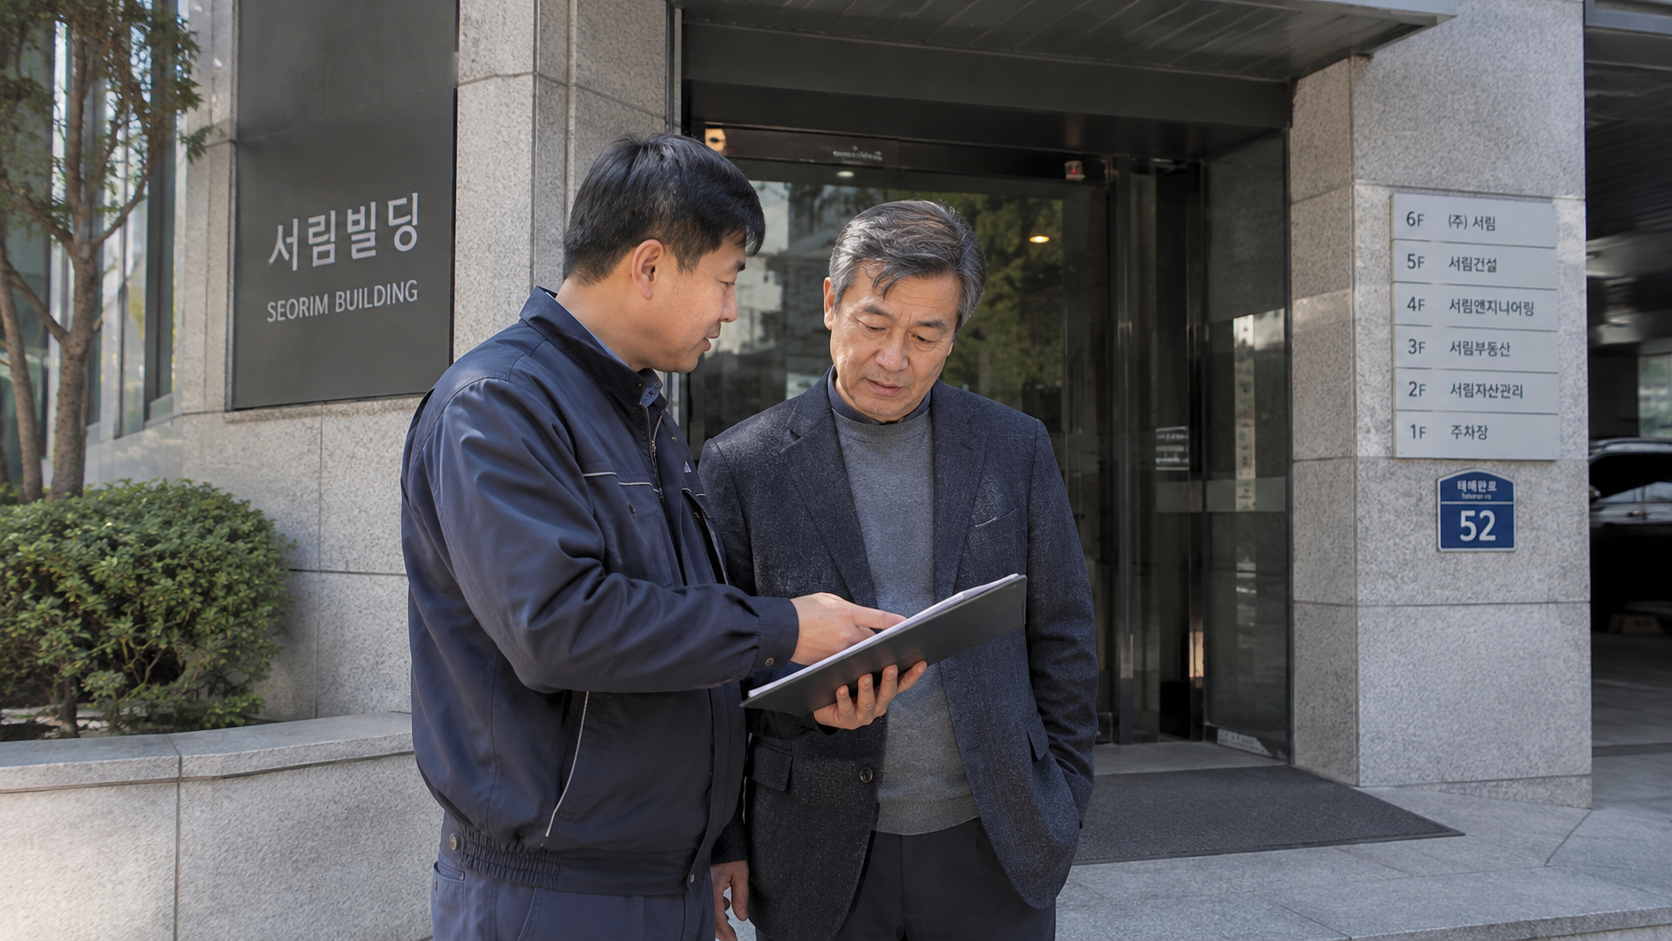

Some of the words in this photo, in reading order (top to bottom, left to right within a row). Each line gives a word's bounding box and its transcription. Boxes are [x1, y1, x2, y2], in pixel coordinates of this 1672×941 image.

[1406, 210, 1425, 227] 6F
[1447, 213, 1468, 230] (주)
[1472, 215, 1496, 231] 서림
[267, 192, 419, 271] 서림빌딩
[1406, 253, 1425, 270] 5F
[1448, 255, 1497, 273] 서림건설
[266, 293, 329, 323] SEORIM
[335, 279, 418, 313] BUILDING
[1406, 296, 1425, 312] 4F
[1448, 298, 1535, 317] 서림앤지니어링
[1407, 338, 1426, 355] 3F
[1449, 340, 1511, 358] 서림부동산
[1408, 381, 1426, 398] 2F
[1450, 382, 1524, 400] 서림자산관리
[1410, 423, 1427, 440] 1F
[1450, 424, 1489, 441] 주차장
[1459, 509, 1497, 542] 52
